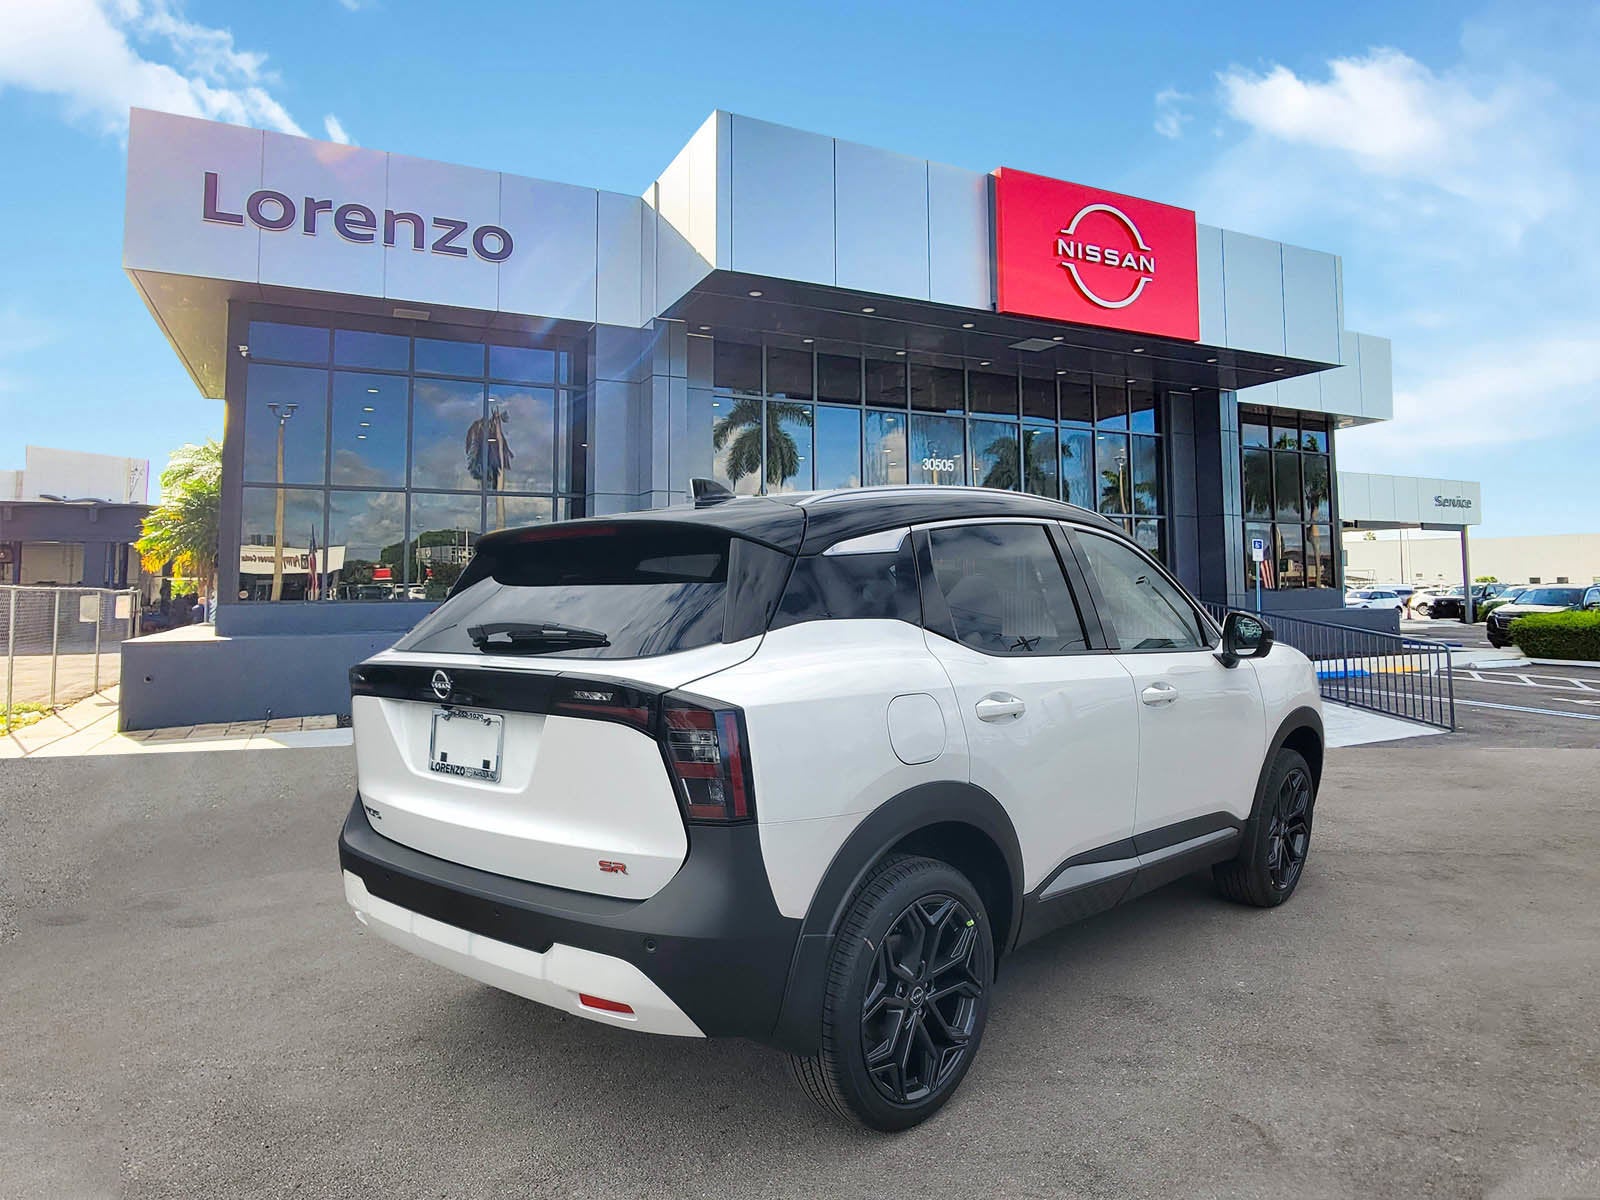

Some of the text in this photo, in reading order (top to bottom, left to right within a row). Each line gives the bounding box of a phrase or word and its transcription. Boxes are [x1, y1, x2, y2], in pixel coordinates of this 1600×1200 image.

[203, 171, 515, 262] Lorenzo
[1057, 238, 1155, 273] NISSAN
[922, 458, 955, 471] 30505
[1434, 495, 1472, 508] Service
[431, 761, 466, 776] LORENZO
[598, 860, 629, 875] SR
